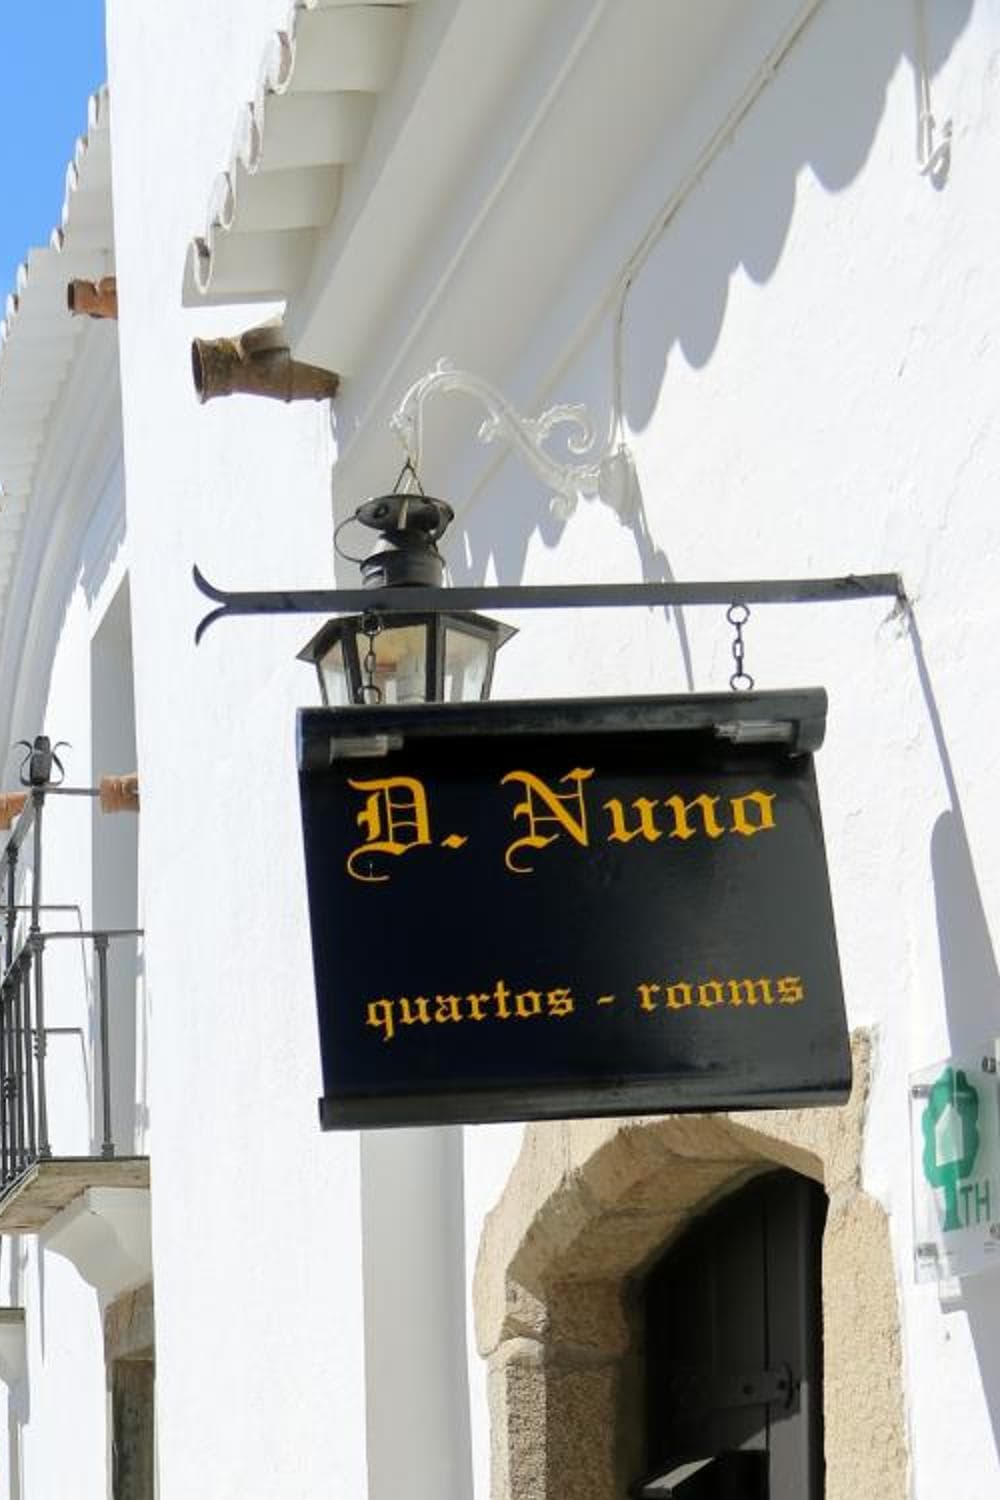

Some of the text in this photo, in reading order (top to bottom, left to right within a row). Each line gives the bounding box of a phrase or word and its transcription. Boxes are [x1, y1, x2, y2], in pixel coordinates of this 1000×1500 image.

[347, 767, 777, 881] D. Nuno
[365, 981, 576, 1041] quartos
[637, 975, 805, 1013] rooms
[959, 1179, 991, 1228] TH
